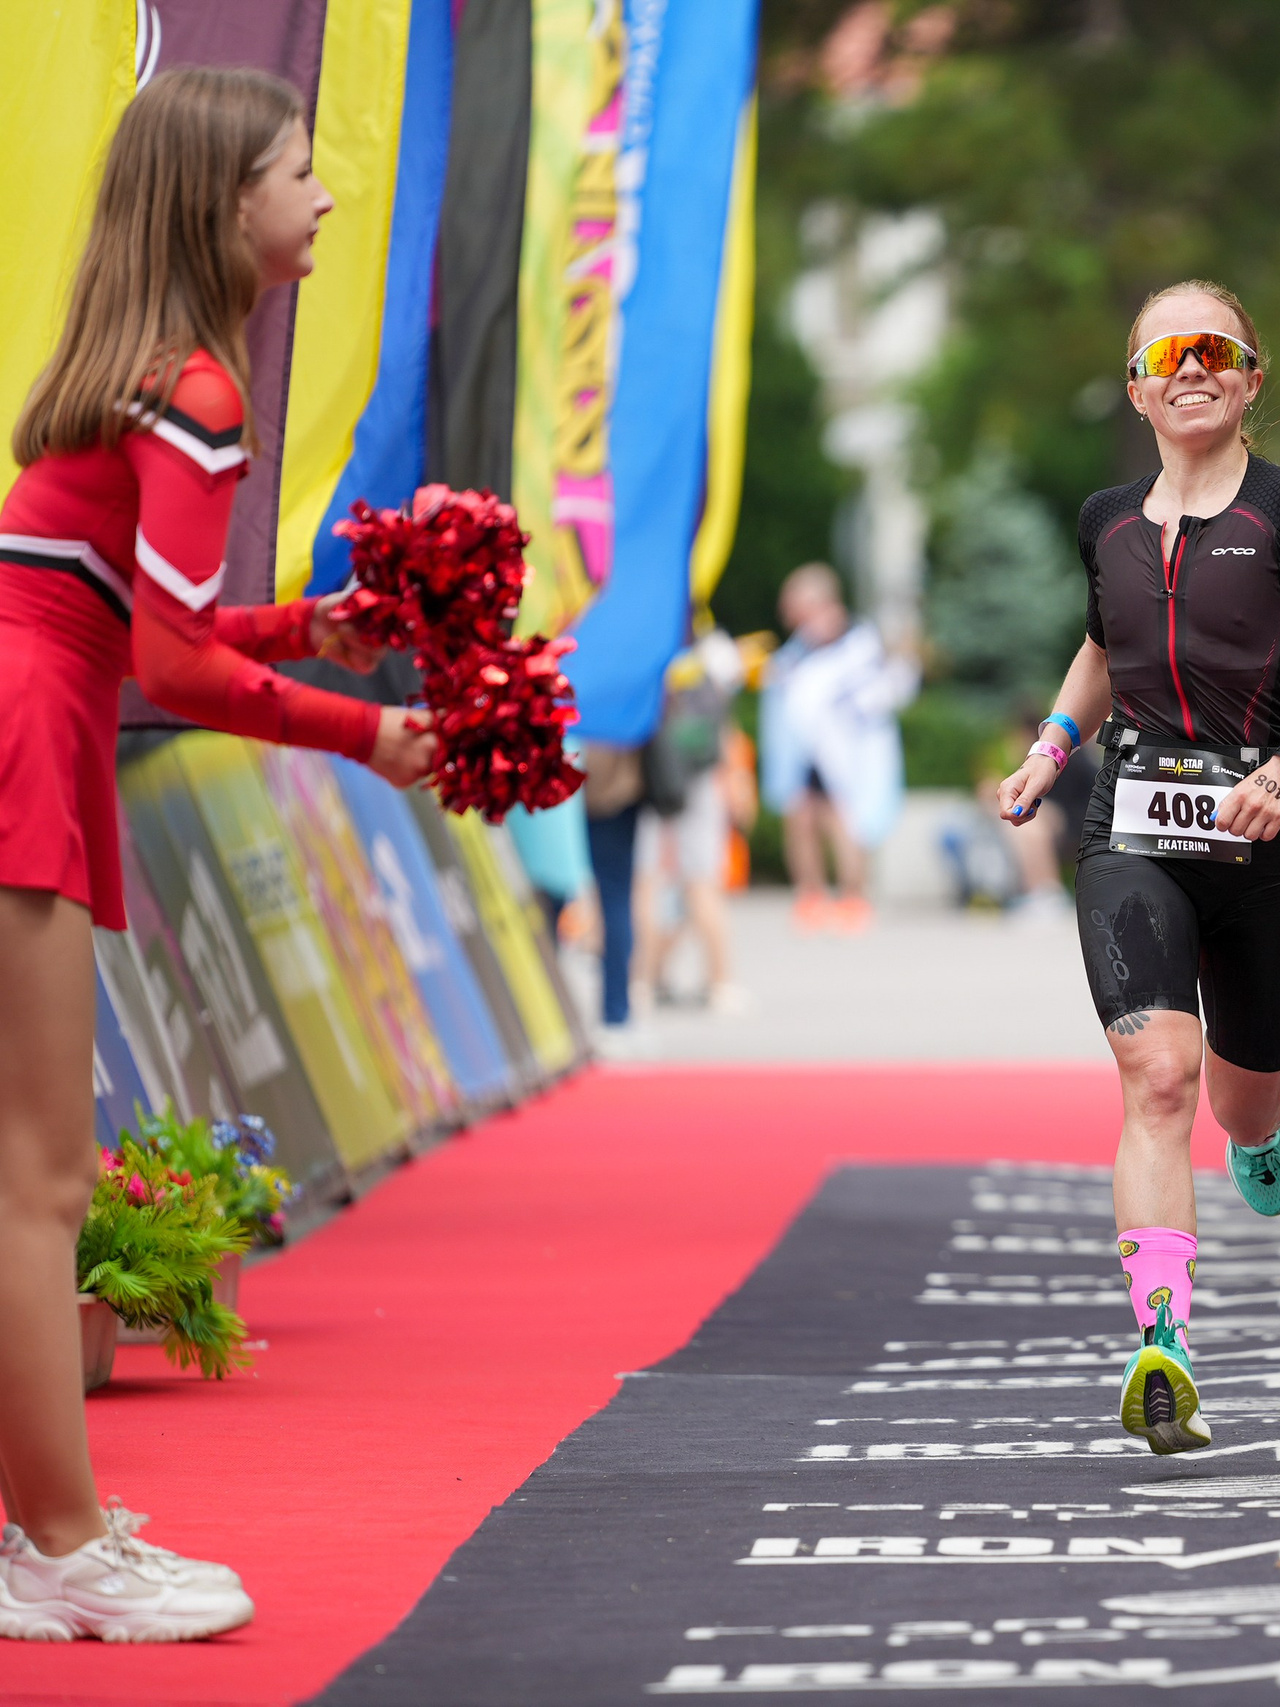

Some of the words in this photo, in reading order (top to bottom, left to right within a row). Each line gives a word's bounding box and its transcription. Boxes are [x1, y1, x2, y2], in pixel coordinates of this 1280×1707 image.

[1211, 547, 1256, 556] orca
[1158, 756, 1176, 768] IRON
[1182, 757, 1204, 770] STAR
[1147, 791, 1217, 831] 408
[1157, 838, 1211, 853] EKATERINA
[1090, 909, 1130, 981] orca
[749, 1536, 1184, 1557] IRON
[665, 1657, 1171, 1689] IRON
